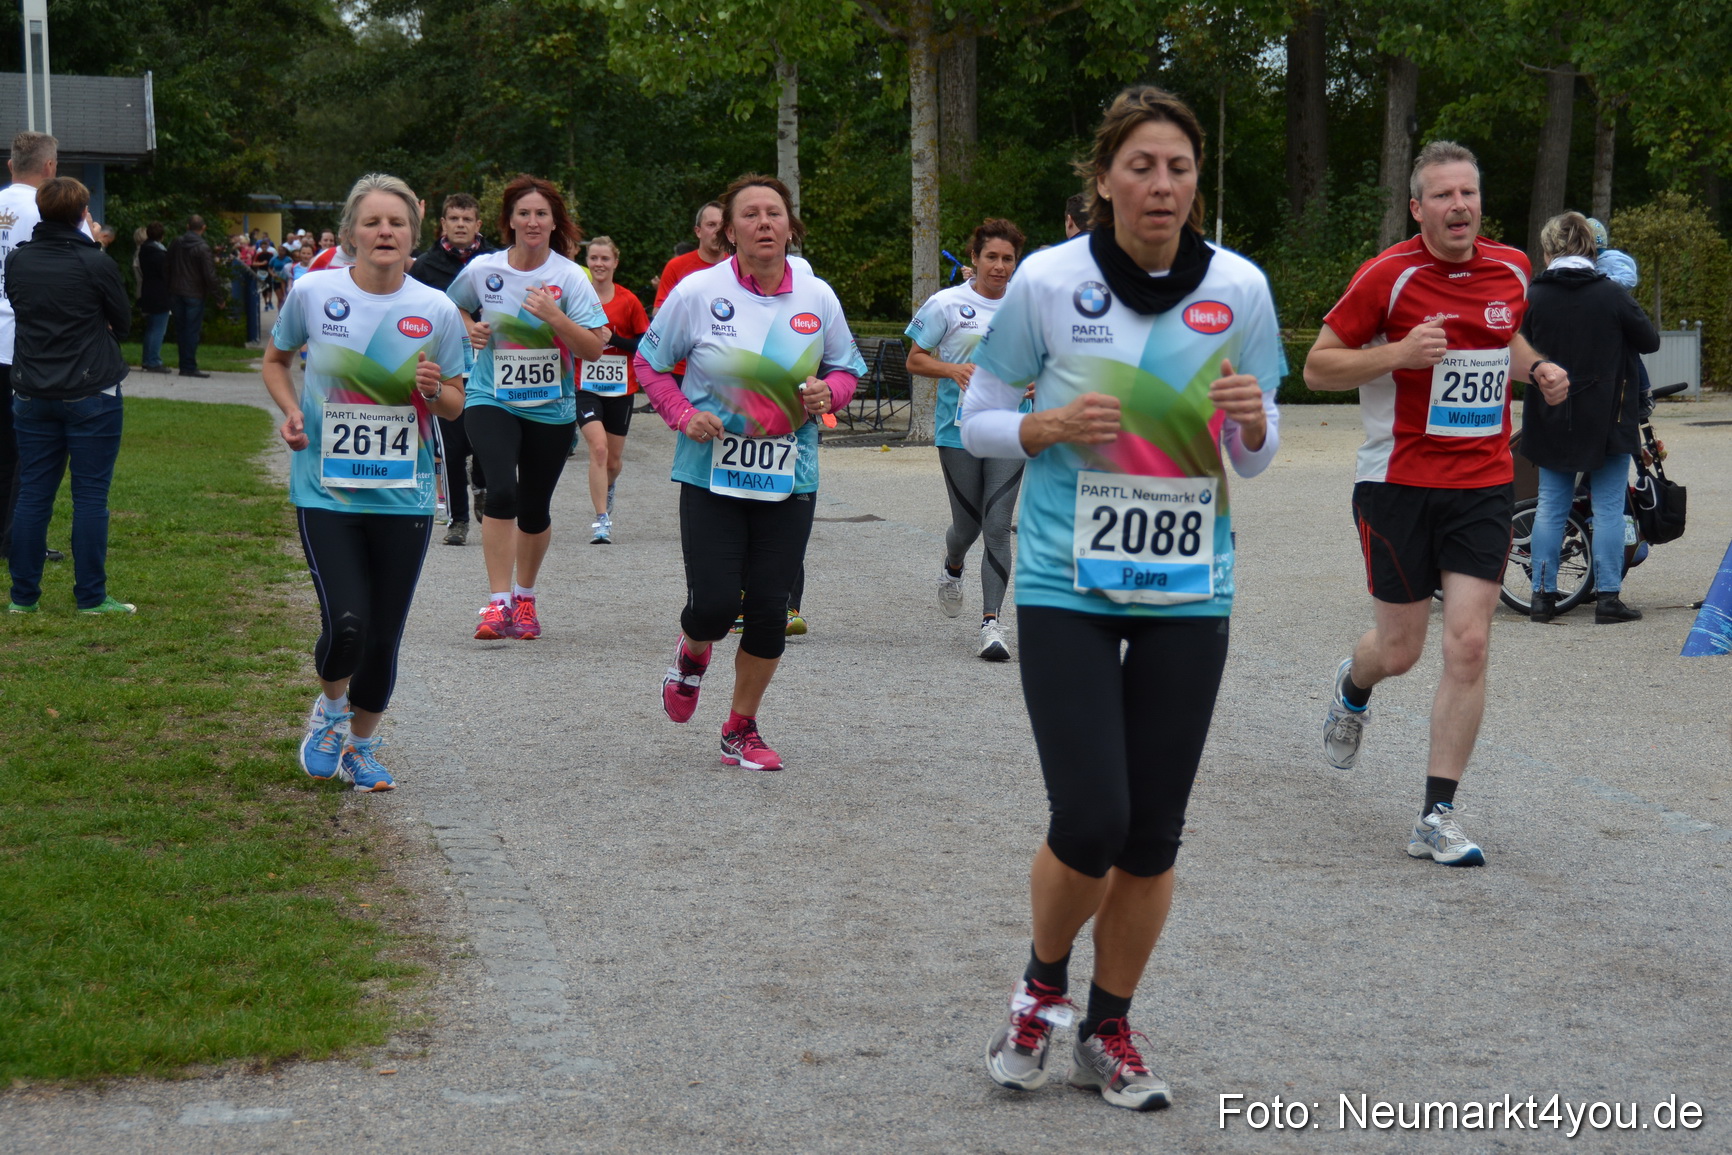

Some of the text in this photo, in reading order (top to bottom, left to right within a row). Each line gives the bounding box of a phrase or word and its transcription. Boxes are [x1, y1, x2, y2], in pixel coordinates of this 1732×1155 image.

[794, 318, 818, 330] Hervis
[1189, 308, 1229, 326] Hervis
[322, 324, 350, 333] PARTL
[322, 330, 350, 338] Neumarkt
[402, 320, 429, 333] Hervis
[711, 324, 737, 332] PARTL
[1072, 325, 1113, 336] PARTL
[1072, 335, 1113, 344] Neumarkt
[1441, 358, 1503, 367] ARTL Neumarkt
[501, 363, 555, 386] 2456
[586, 364, 624, 382] 2635
[1441, 370, 1505, 403] 2588
[508, 389, 548, 401] Sieglinde
[325, 410, 404, 422] PARTL Neumarkt
[1448, 411, 1496, 427] Wolfgang
[332, 423, 410, 456] 2614
[721, 437, 792, 470] 2007
[352, 463, 388, 477] Ulrike
[727, 470, 774, 489] MARA
[1080, 484, 1195, 503] PARTL Neumarkt
[1090, 505, 1202, 557] 2088
[1122, 567, 1168, 587] Petra
